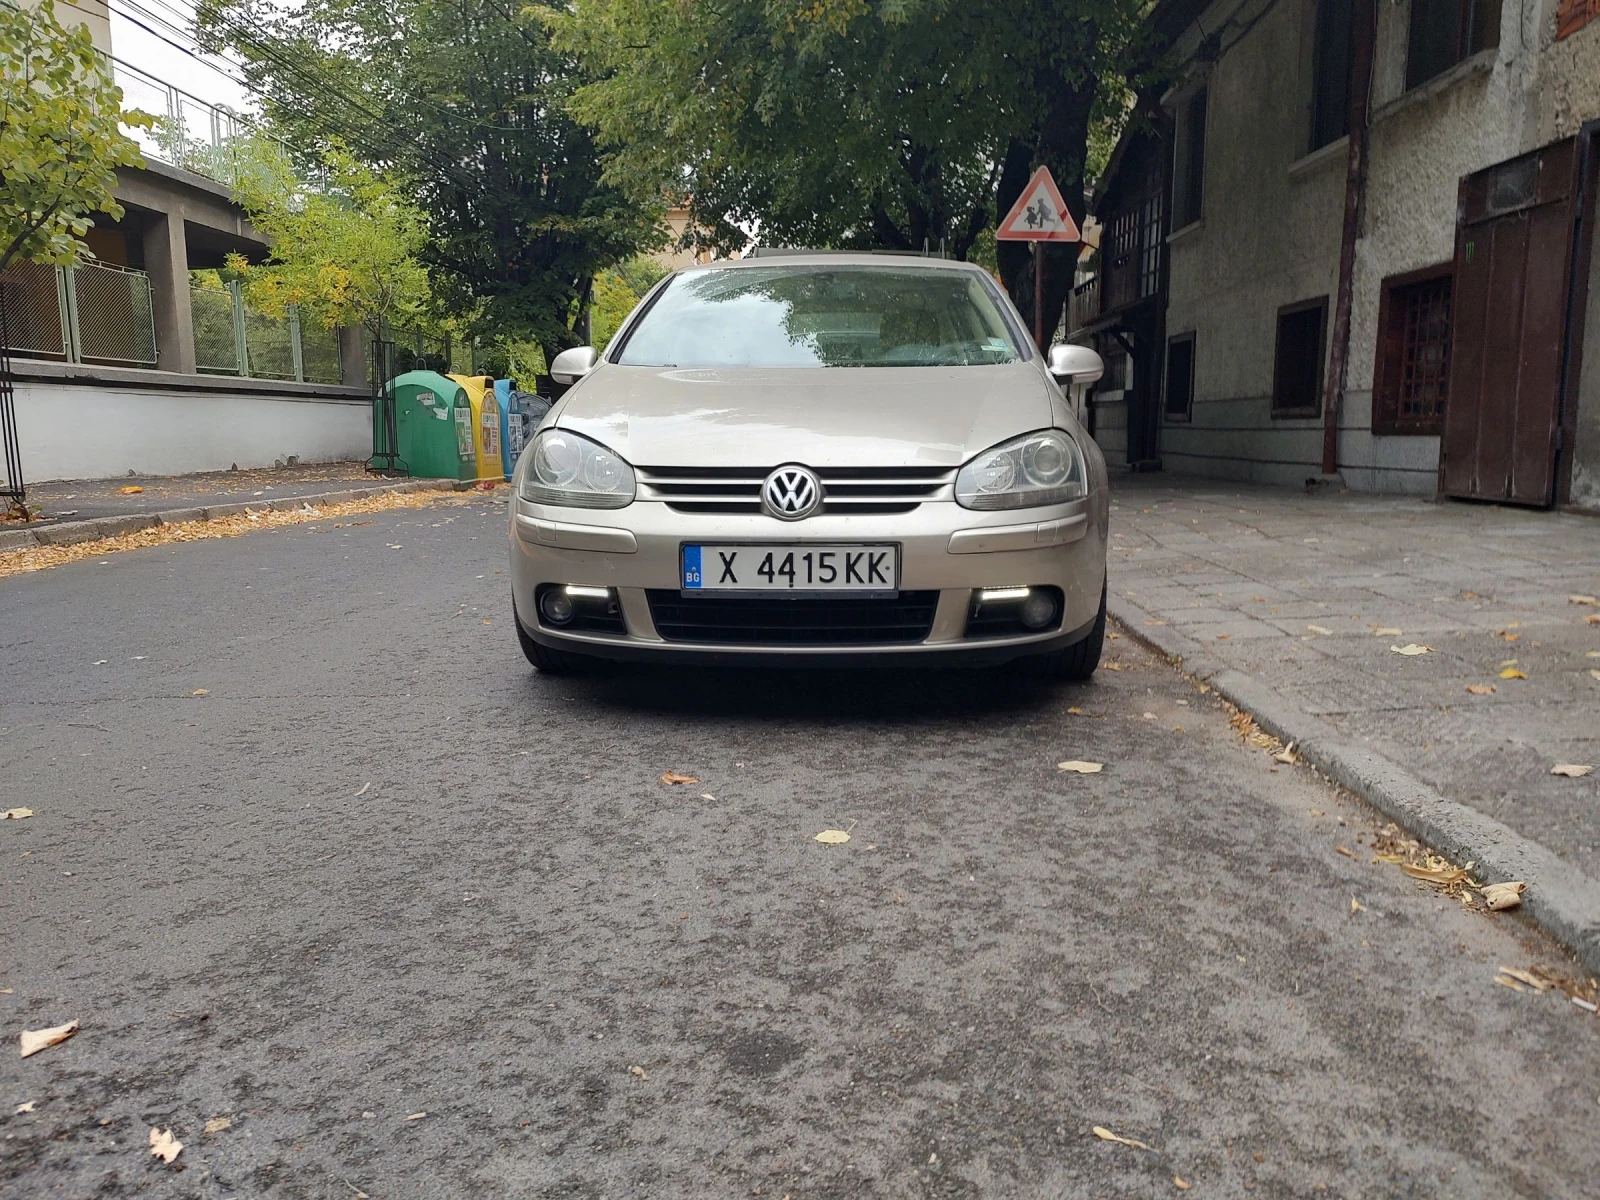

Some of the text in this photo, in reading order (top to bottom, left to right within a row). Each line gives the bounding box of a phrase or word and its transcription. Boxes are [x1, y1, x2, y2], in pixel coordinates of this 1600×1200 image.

[768, 472, 814, 513] VW
[686, 572, 700, 583] BG
[718, 551, 738, 584] X
